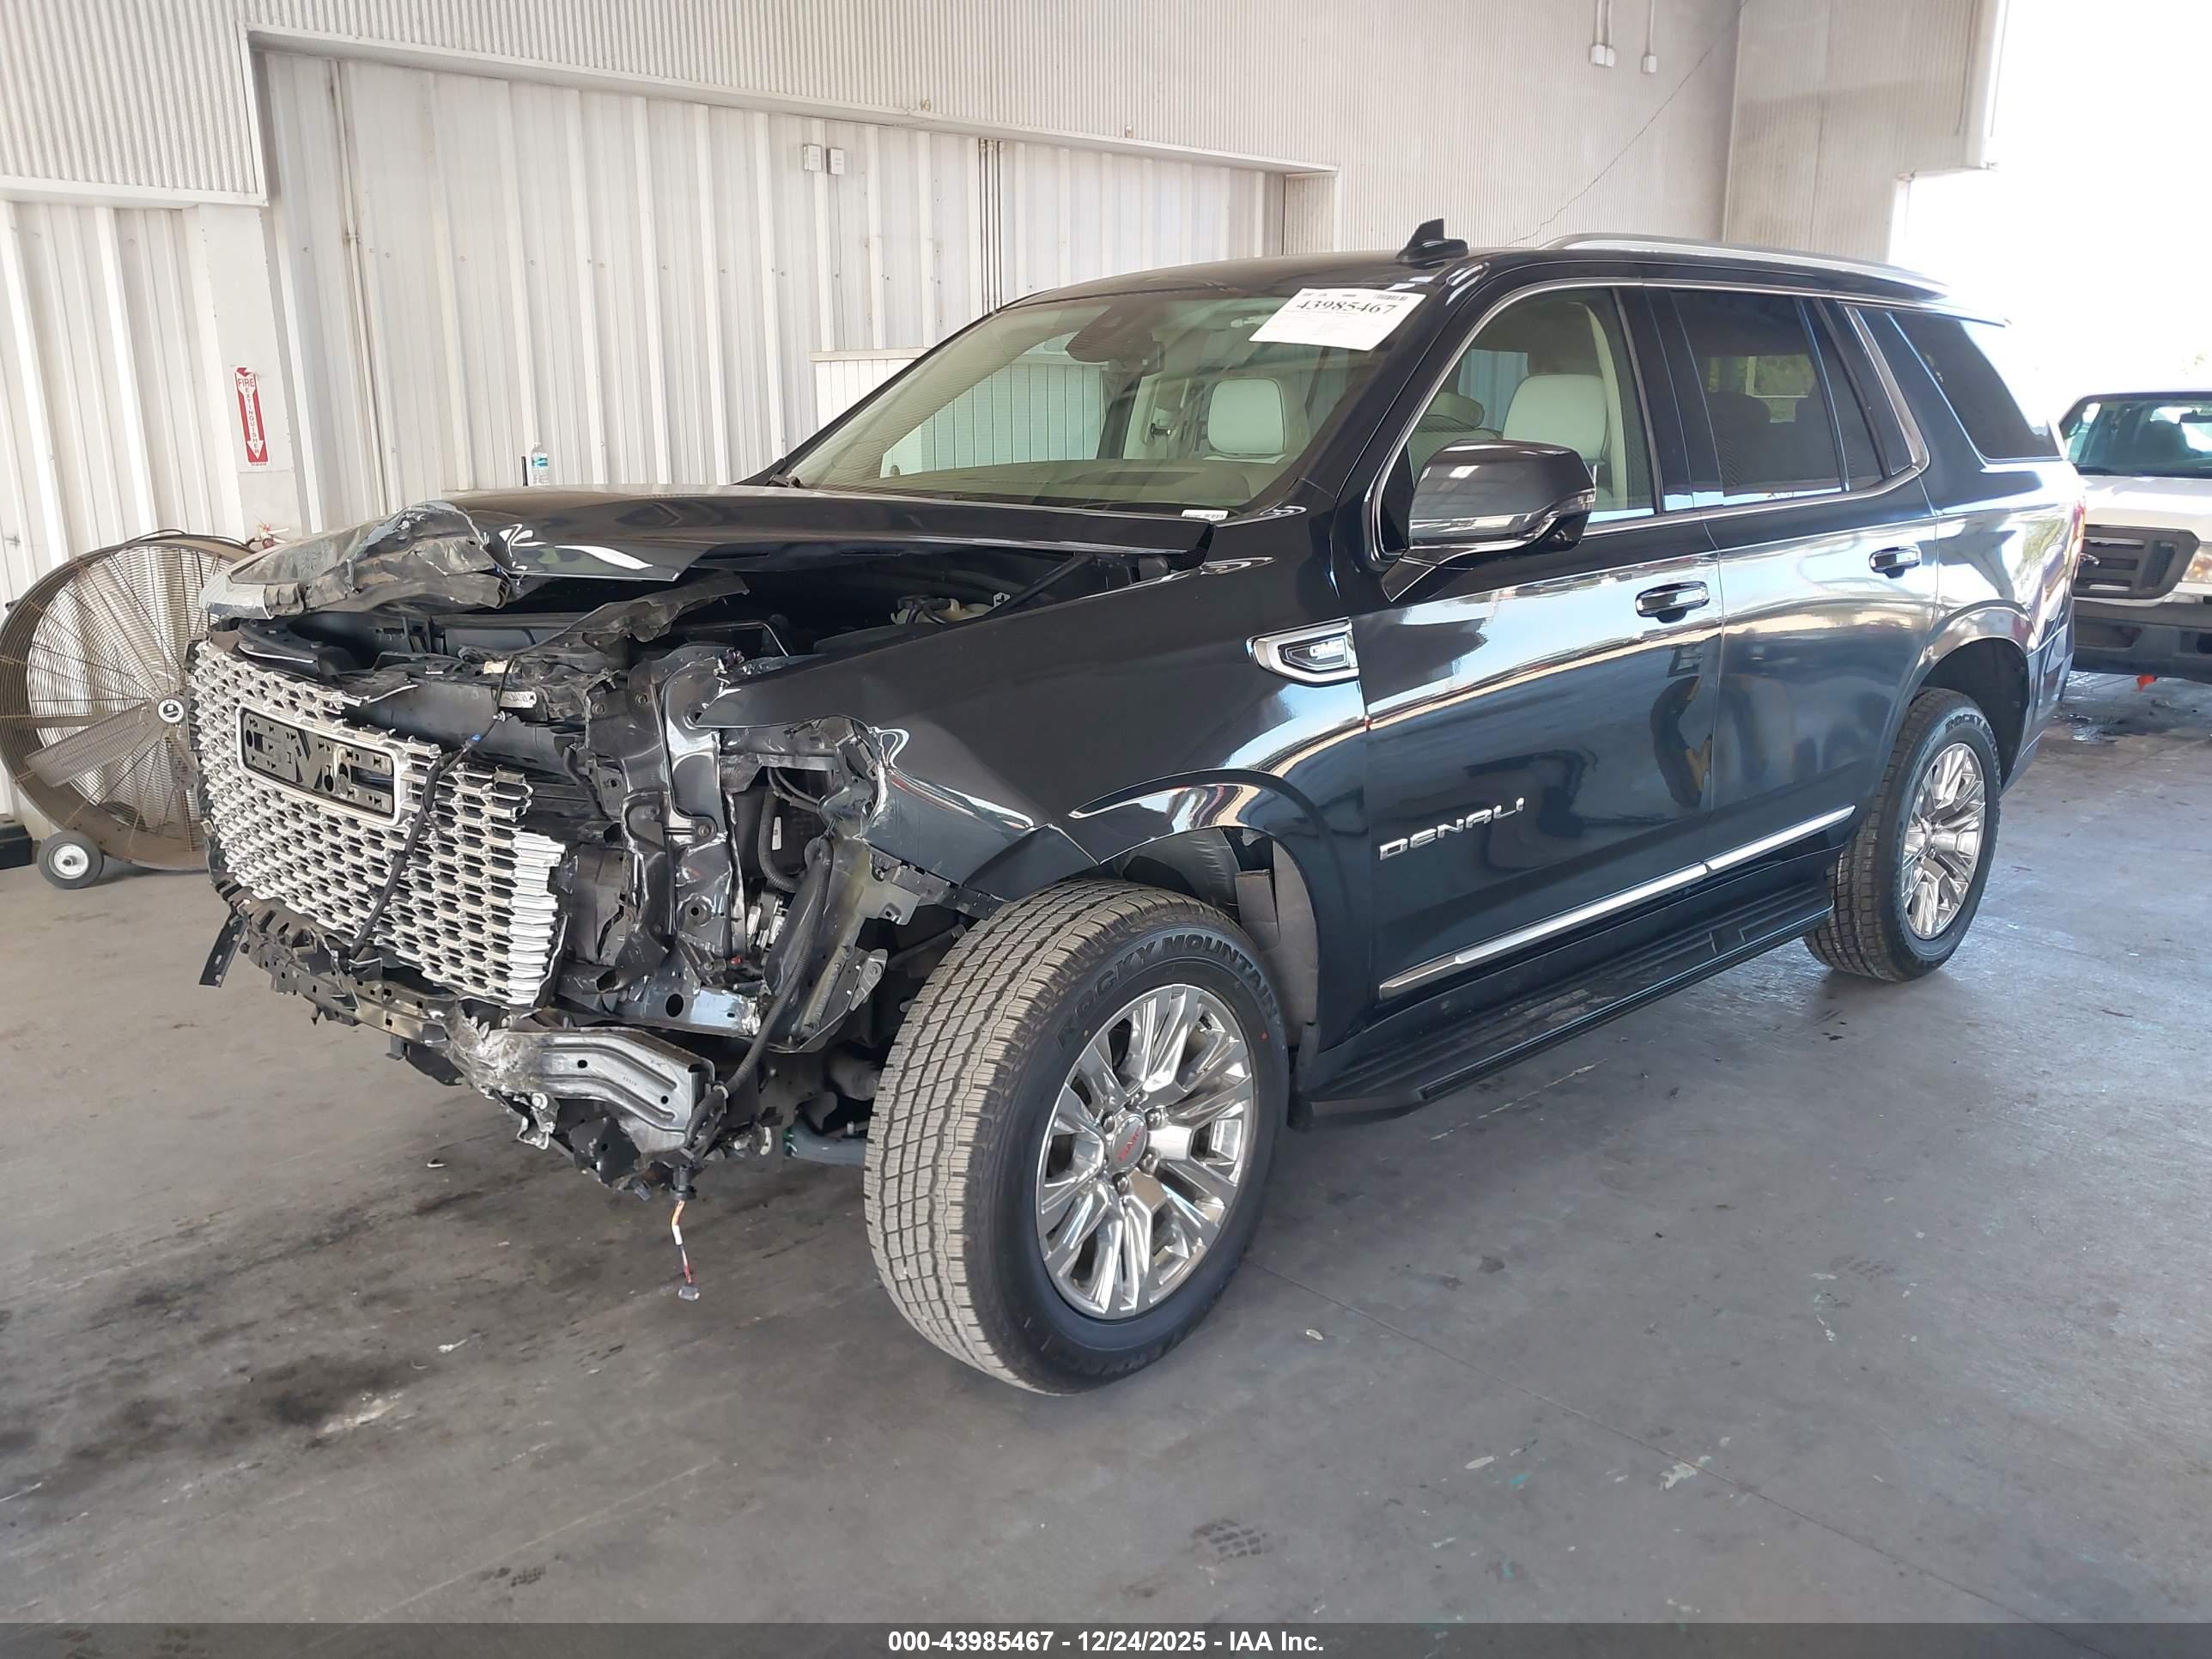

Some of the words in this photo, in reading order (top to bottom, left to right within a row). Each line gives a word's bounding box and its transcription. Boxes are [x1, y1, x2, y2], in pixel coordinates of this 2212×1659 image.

[1296, 300, 1398, 315] 43985467
[238, 379, 256, 387] FIRE
[245, 388, 259, 453] EXTINGUISHER
[1379, 797, 1525, 861] DENALI
[1057, 940, 1155, 1049] ROCKY
[1160, 934, 1279, 1020] MOUNTAIN
